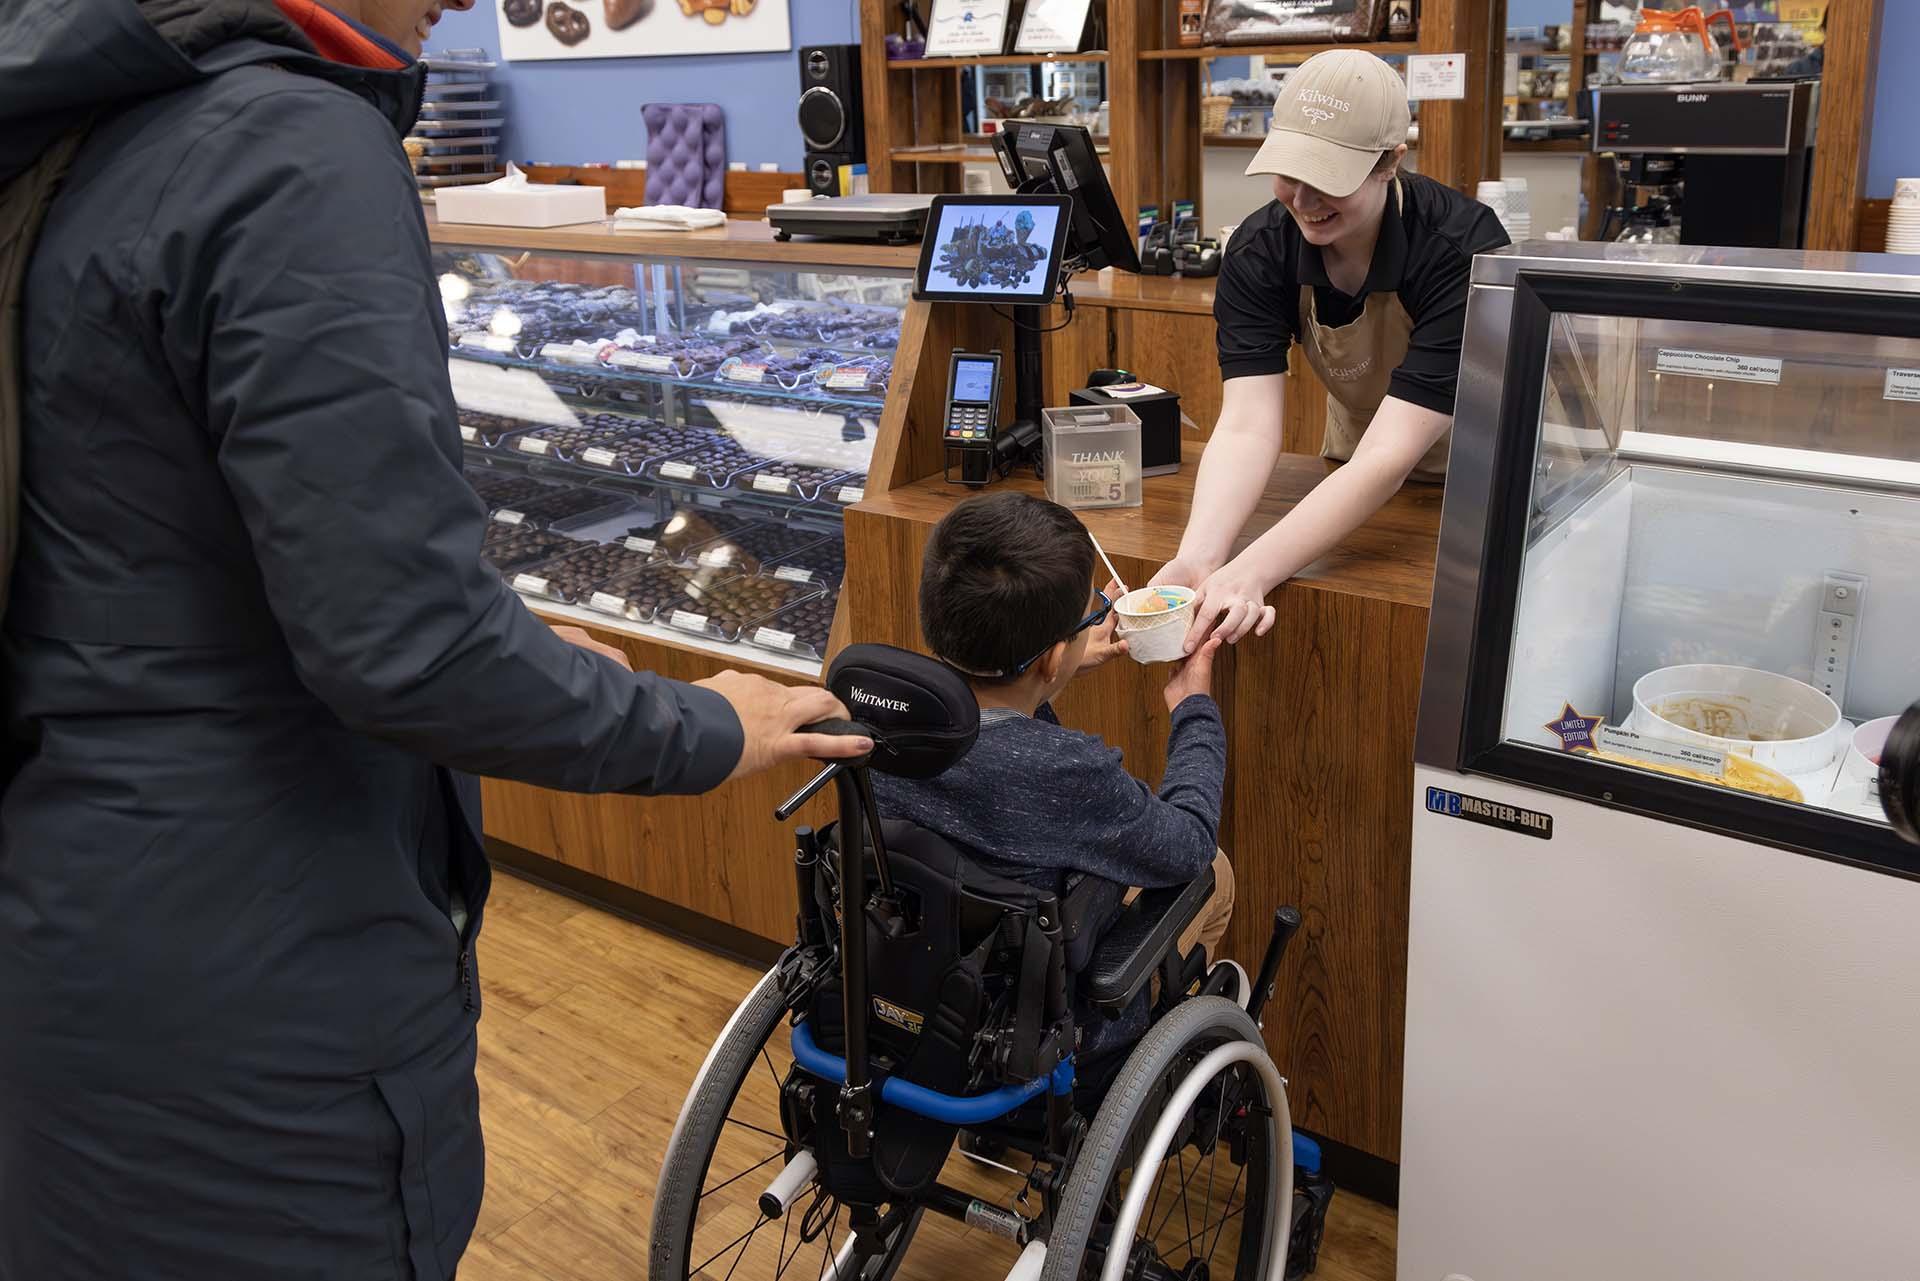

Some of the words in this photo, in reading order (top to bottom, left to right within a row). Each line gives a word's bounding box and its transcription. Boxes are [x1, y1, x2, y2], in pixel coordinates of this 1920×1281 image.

[1298, 88, 1350, 112] Kilwins
[1677, 94, 1707, 102] BUNN
[1658, 350, 1693, 359] Cappuccino
[1694, 353, 1725, 361] Chocolate
[1071, 450, 1125, 464] THANK
[851, 685, 908, 713] WHITMYER
[1560, 719, 1586, 730] LIMITED
[1563, 731, 1589, 742] EDITION
[1604, 728, 1628, 738] Pumpkin
[1461, 797, 1549, 830] MASTER-BILT
